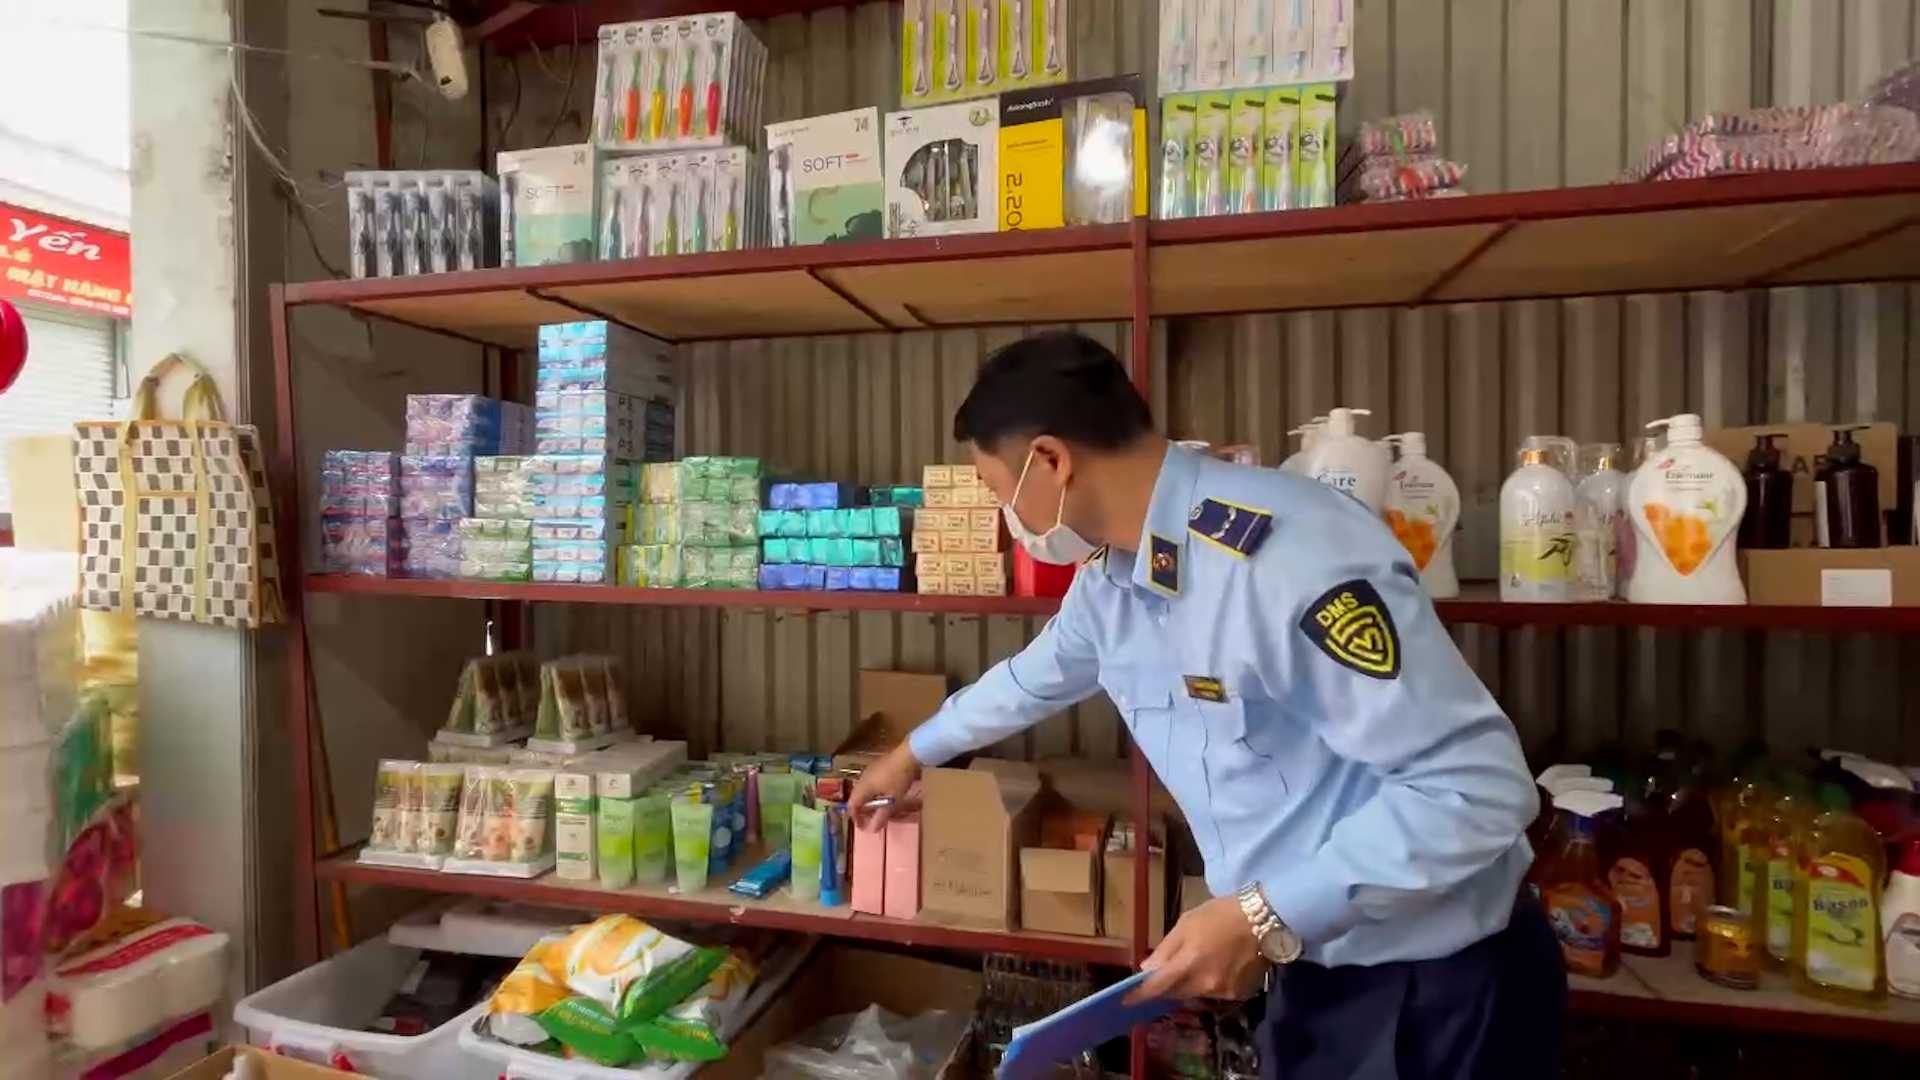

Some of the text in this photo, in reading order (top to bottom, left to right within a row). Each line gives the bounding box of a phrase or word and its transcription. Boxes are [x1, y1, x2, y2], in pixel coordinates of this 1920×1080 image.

[802, 154, 844, 173] SOFT
[9, 217, 102, 261] Yến
[1315, 591, 1360, 627] DMS
